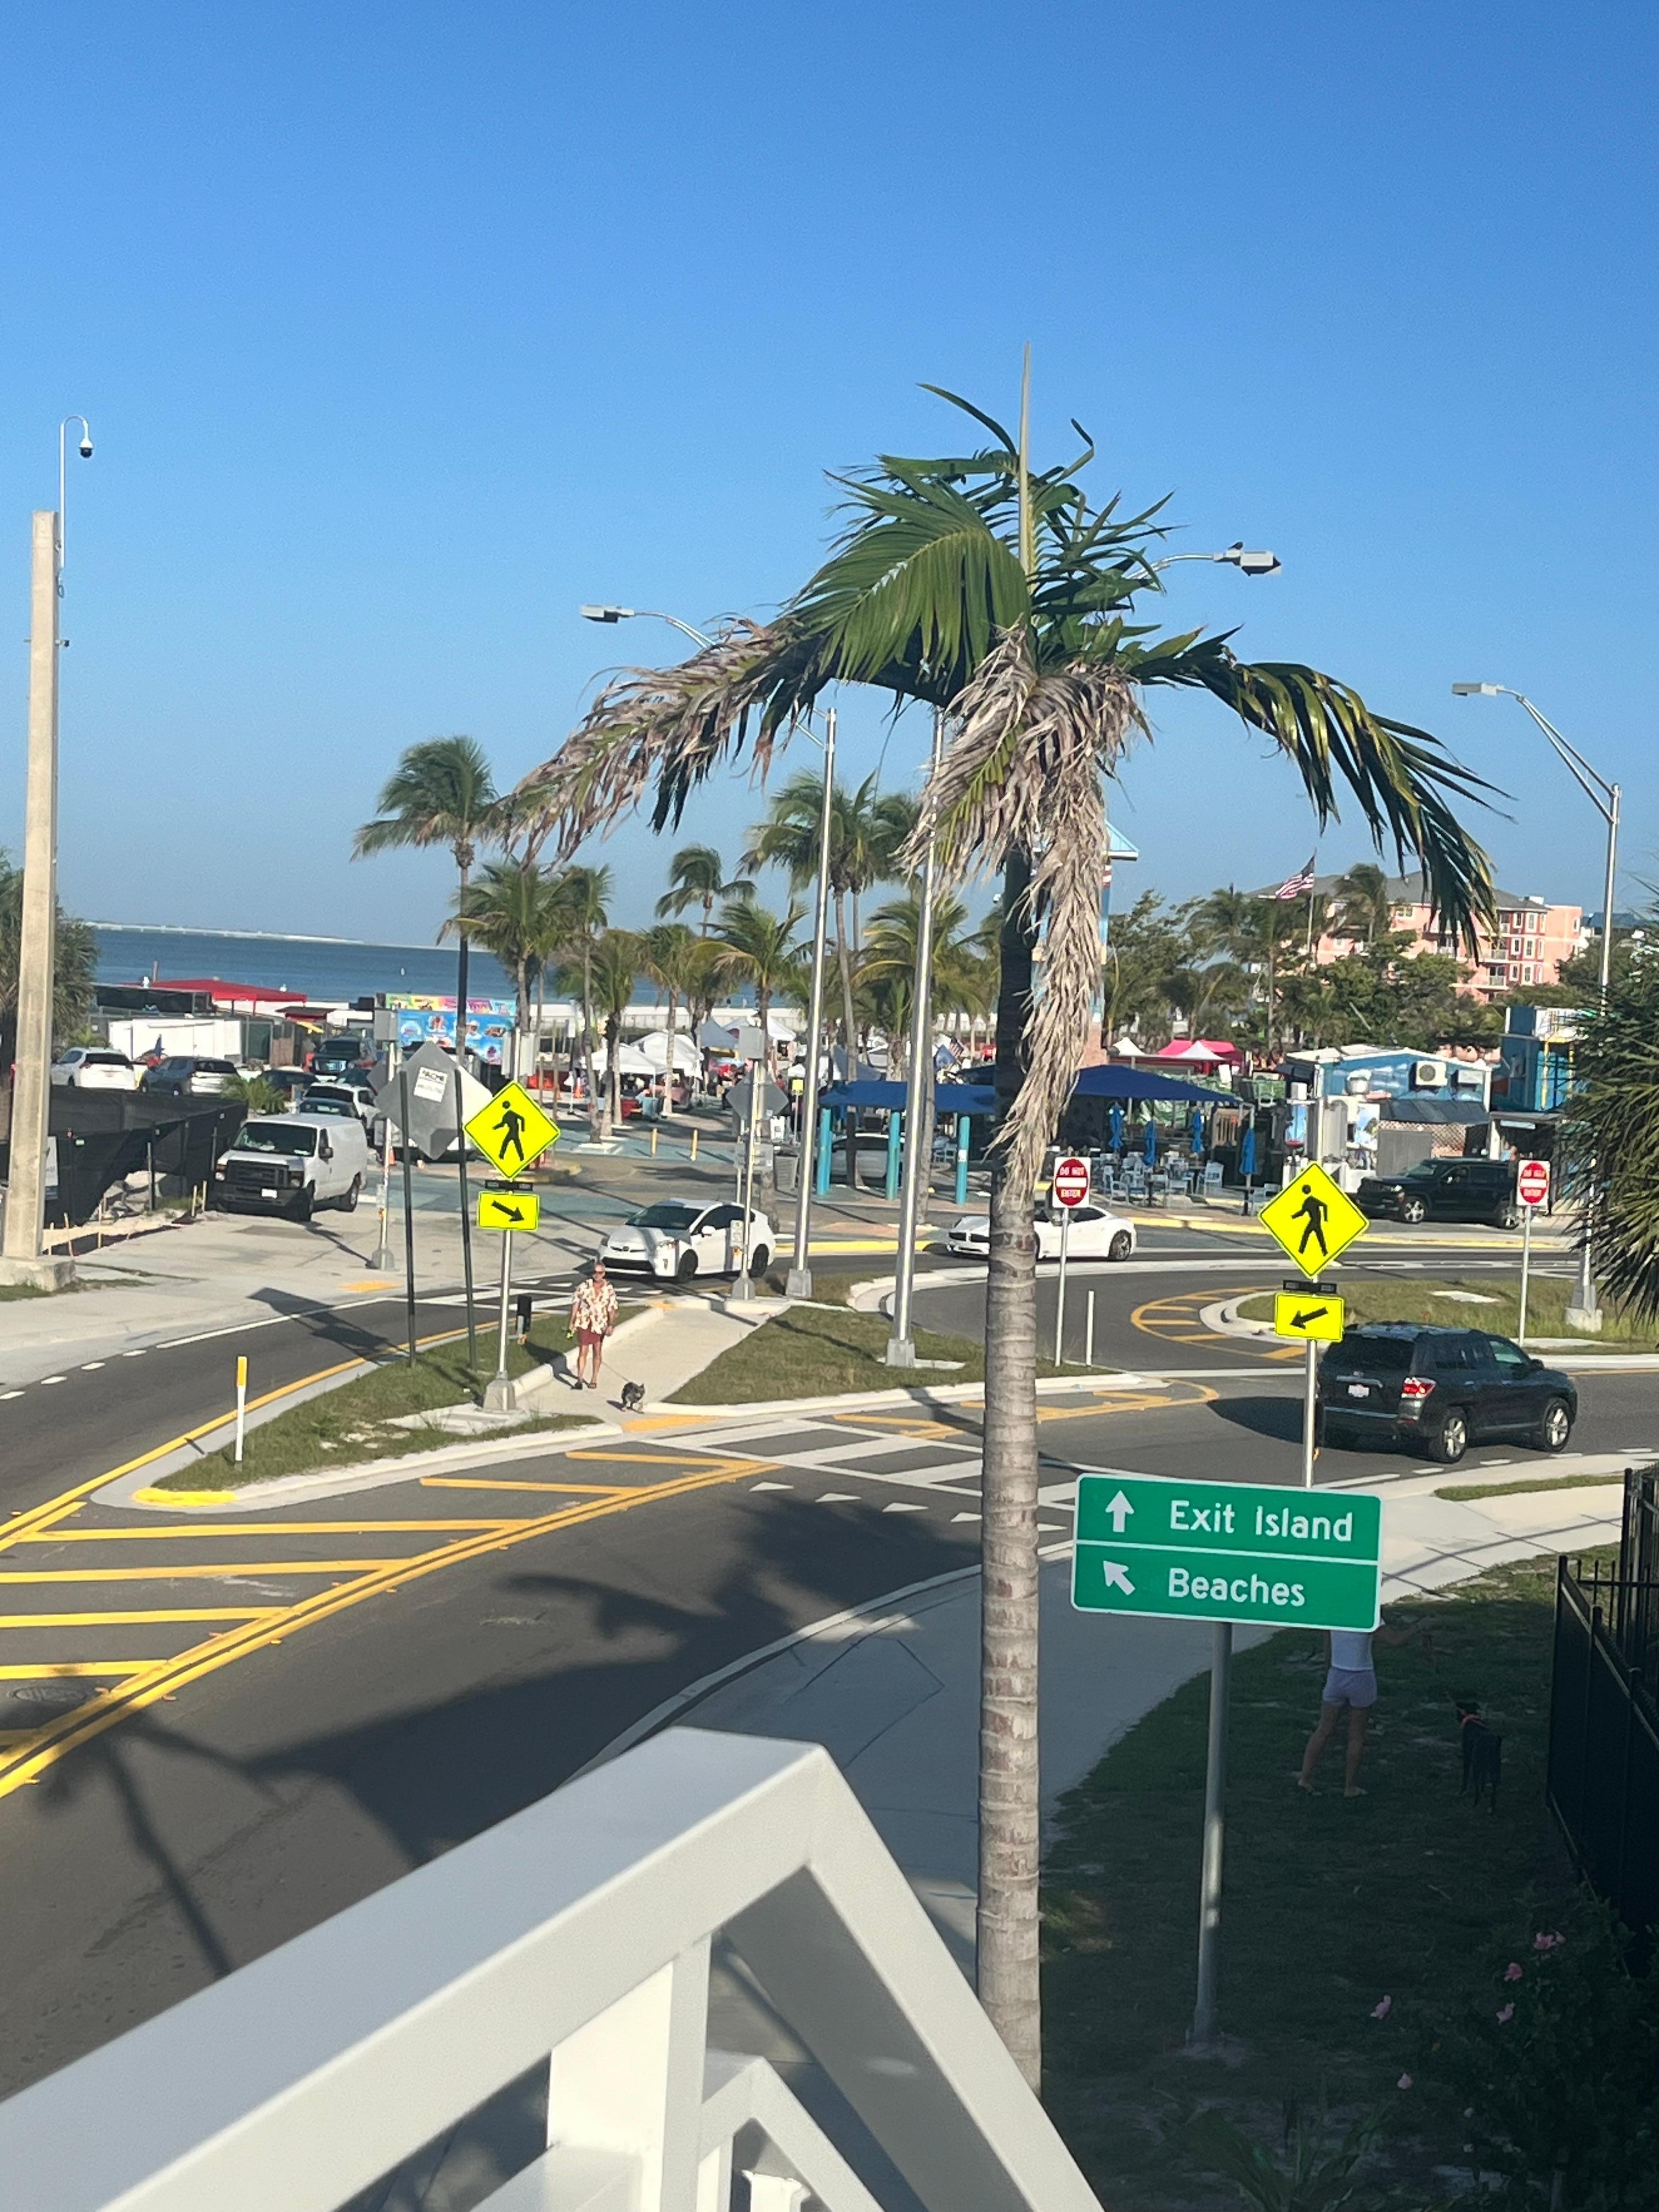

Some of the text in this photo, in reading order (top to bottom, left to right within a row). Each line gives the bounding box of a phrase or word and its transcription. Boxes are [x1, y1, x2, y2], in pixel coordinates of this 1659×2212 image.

[1171, 1500, 1353, 1542] Exit Island
[1168, 1567, 1305, 1607] Beaches
